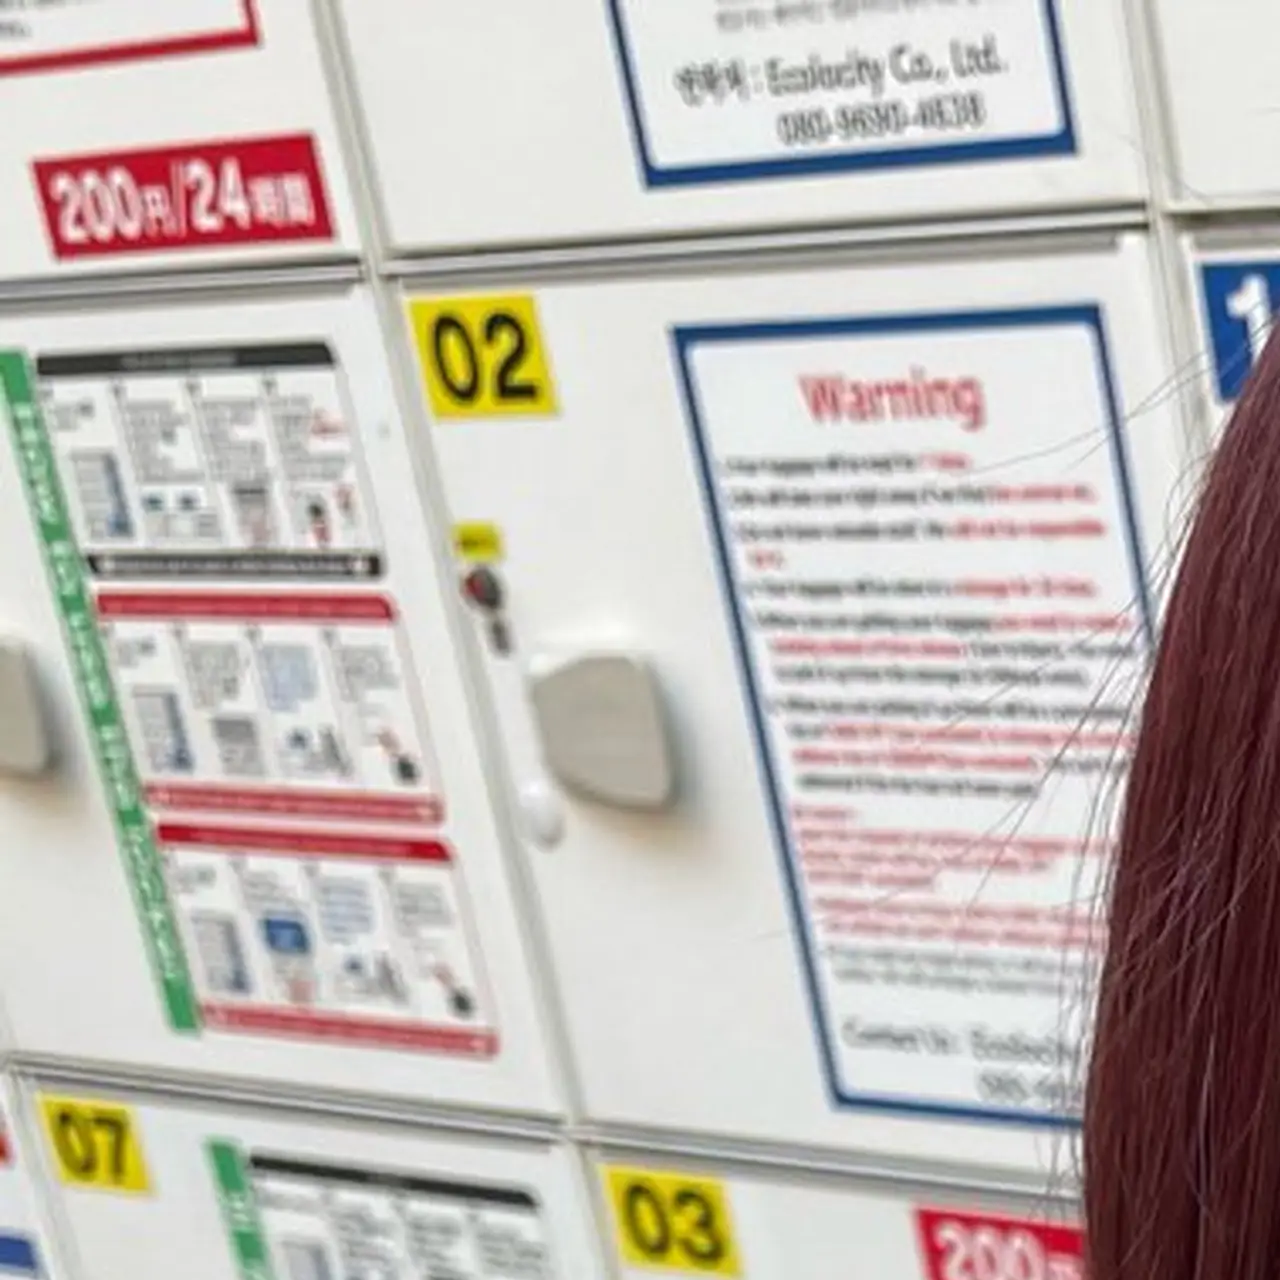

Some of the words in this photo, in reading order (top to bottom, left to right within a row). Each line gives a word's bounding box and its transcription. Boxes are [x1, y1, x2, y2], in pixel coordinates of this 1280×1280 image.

[430, 312, 541, 408] 02
[798, 366, 988, 431] Warning
[50, 1108, 132, 1184] 07
[622, 1184, 727, 1265] 03
